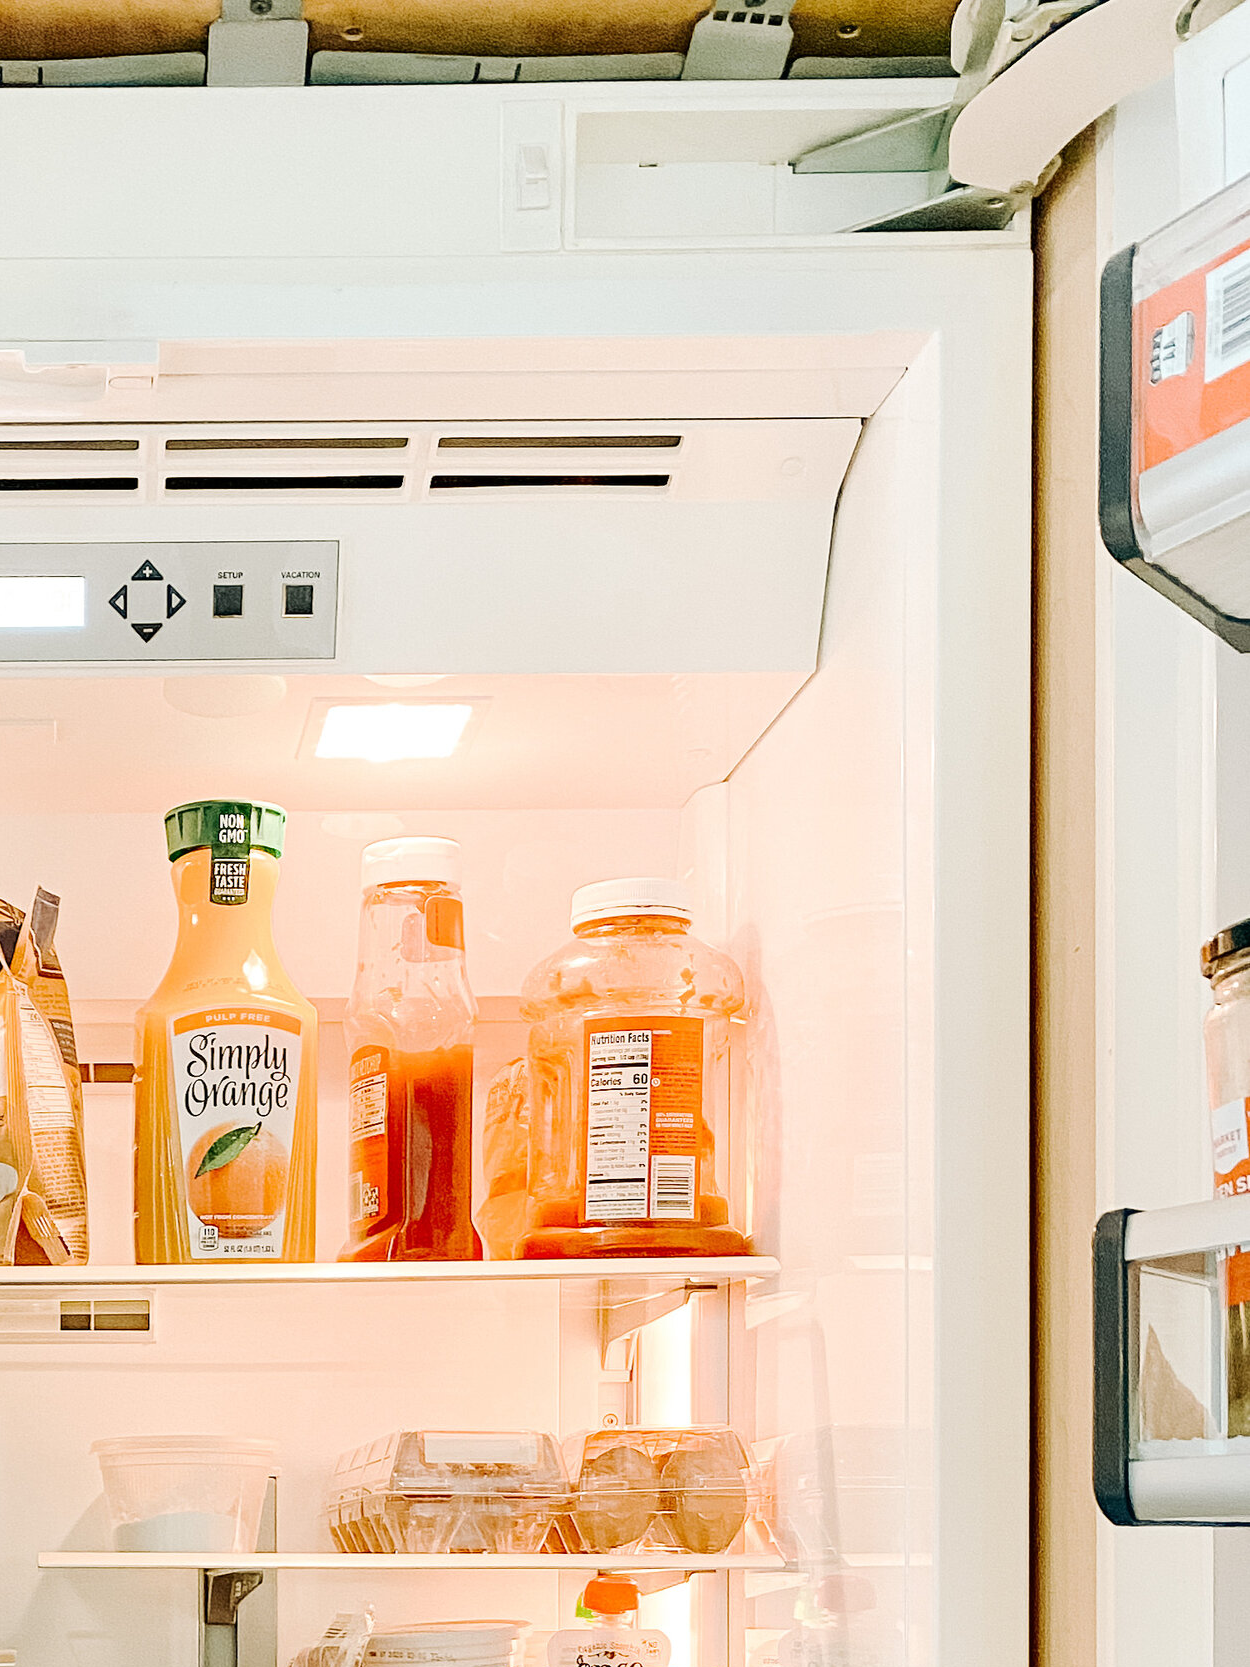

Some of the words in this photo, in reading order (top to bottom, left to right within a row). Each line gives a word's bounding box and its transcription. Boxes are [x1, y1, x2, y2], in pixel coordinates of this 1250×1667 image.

[217, 571, 244, 579] SETUP
[281, 571, 321, 579] VACATION
[219, 813, 245, 829] NON
[218, 829, 246, 844] GMO
[213, 863, 247, 876] FRESH
[214, 875, 246, 888] TASTE
[205, 1013, 237, 1023] PULP
[240, 1012, 272, 1023] FREE
[590, 1033, 626, 1046] Nutrition
[627, 1032, 650, 1043] Facts
[186, 1031, 291, 1084] Simply
[590, 1078, 622, 1088] Calories
[633, 1073, 648, 1085] 60
[184, 1076, 290, 1117] Orange
